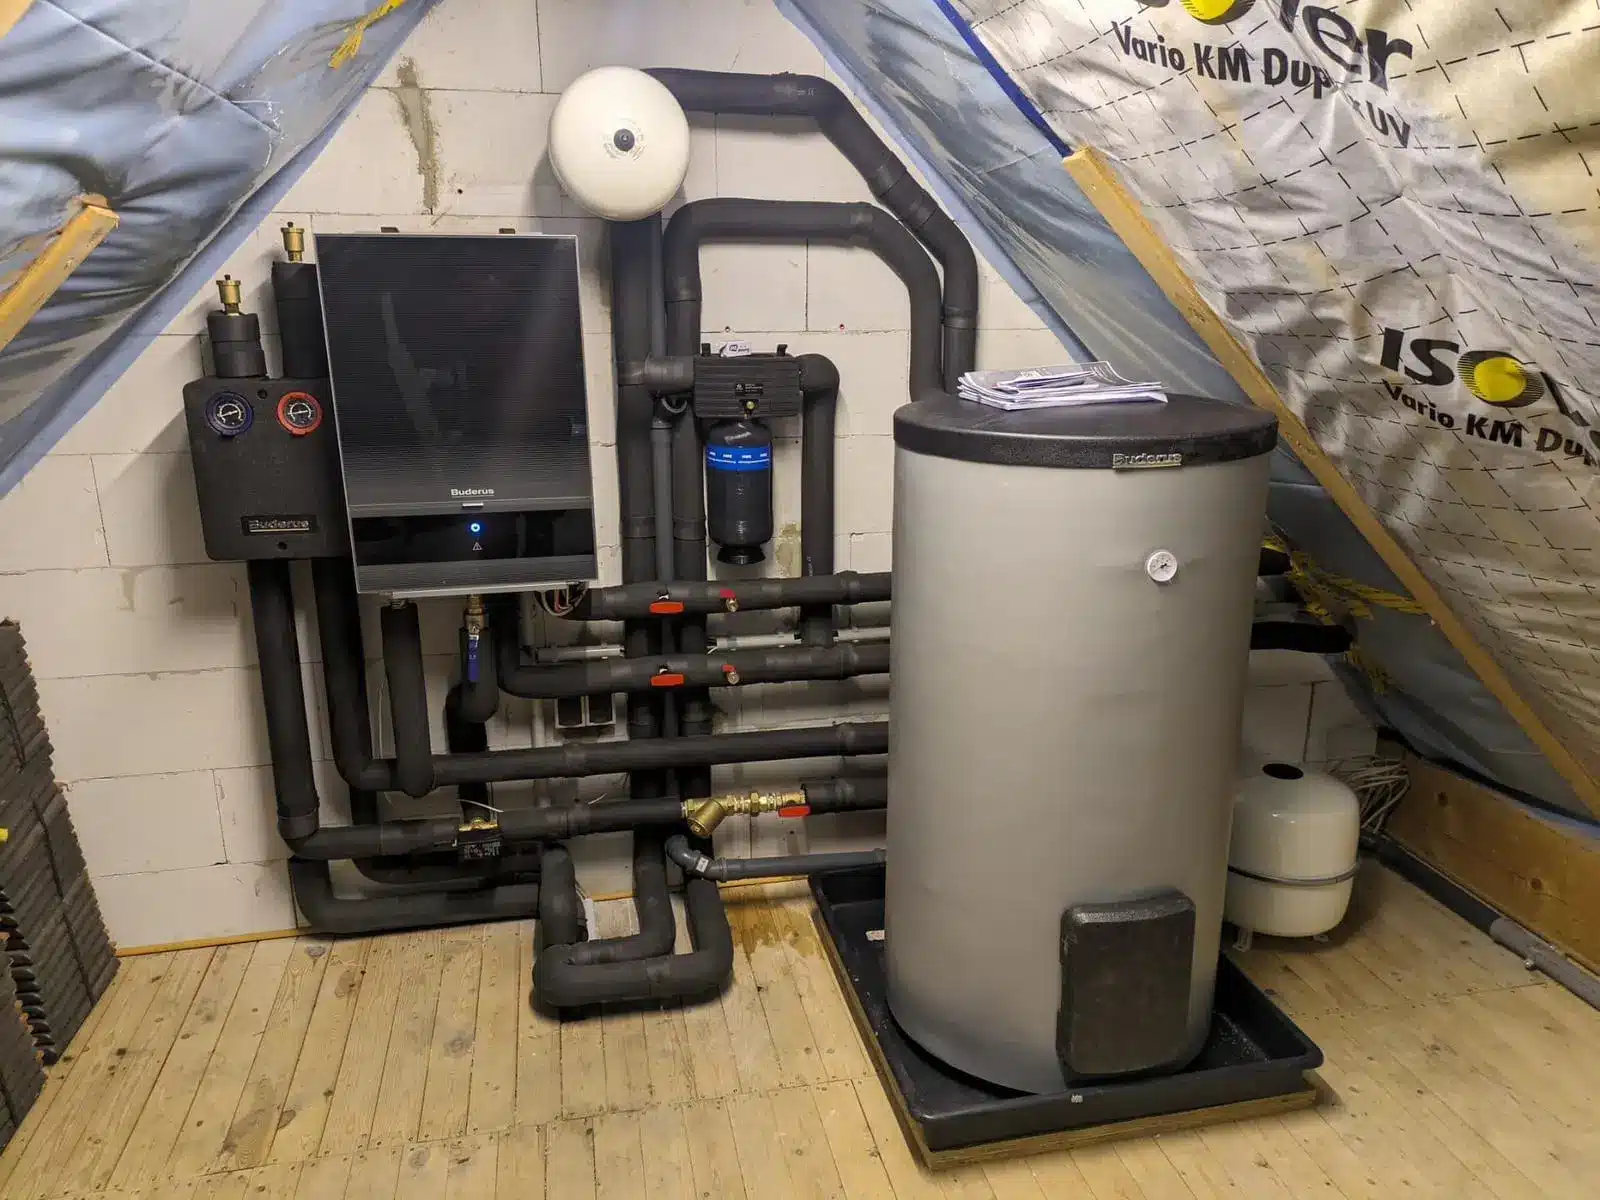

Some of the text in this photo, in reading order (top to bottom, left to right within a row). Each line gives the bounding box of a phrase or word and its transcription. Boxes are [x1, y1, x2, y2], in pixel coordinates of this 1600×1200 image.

[1111, 21, 1185, 71] Vario
[1193, 43, 1251, 82] KM
[1366, 100, 1410, 148] UV
[1382, 379, 1454, 428] Vario
[1466, 413, 1522, 448] KM
[450, 488, 495, 496] Buderus
